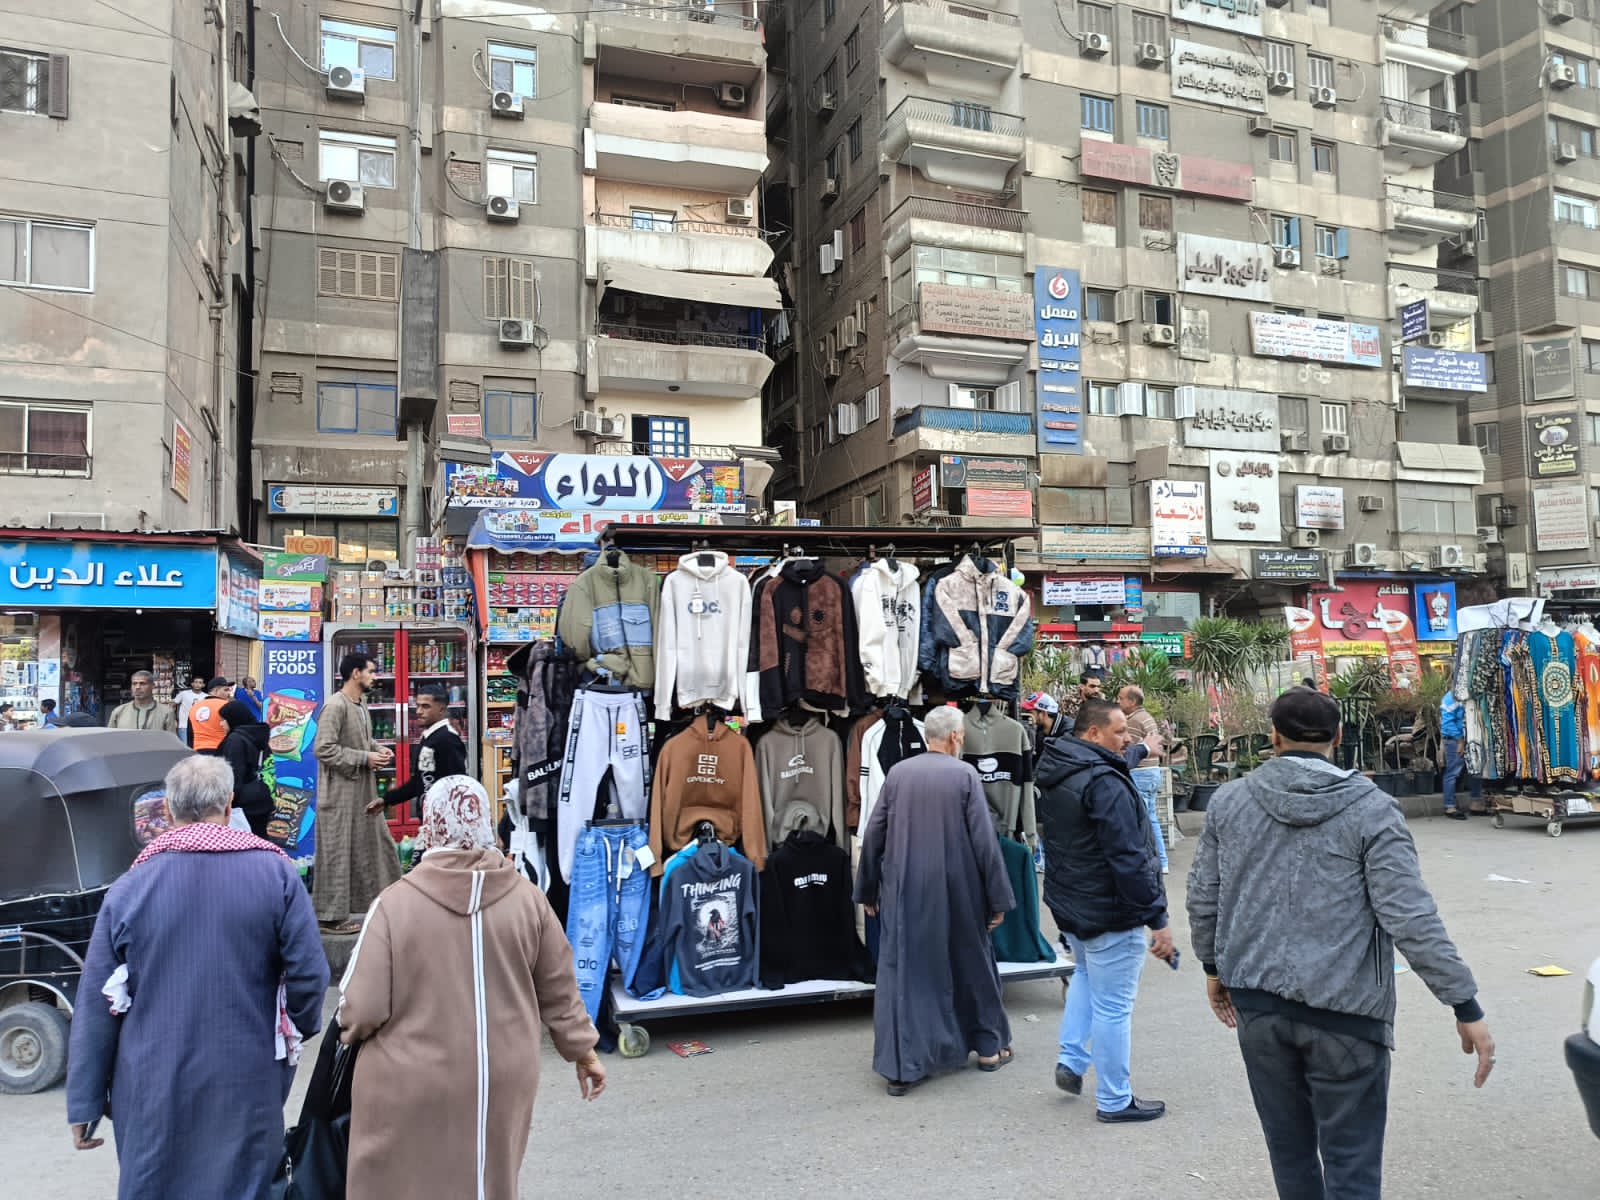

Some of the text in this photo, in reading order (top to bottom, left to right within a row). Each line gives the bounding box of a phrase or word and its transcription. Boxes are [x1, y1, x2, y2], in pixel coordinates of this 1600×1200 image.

[1040, 304, 1078, 320] معمل
[1041, 329, 1079, 349] البرق
[517, 453, 541, 464] ماركت
[556, 461, 652, 507] اللواء
[1156, 481, 1203, 498] السلام
[9, 561, 184, 590] علاء الدين
[268, 650, 317, 662] EGYPT
[268, 662, 316, 675] FOODS
[680, 872, 742, 898] THINKING
